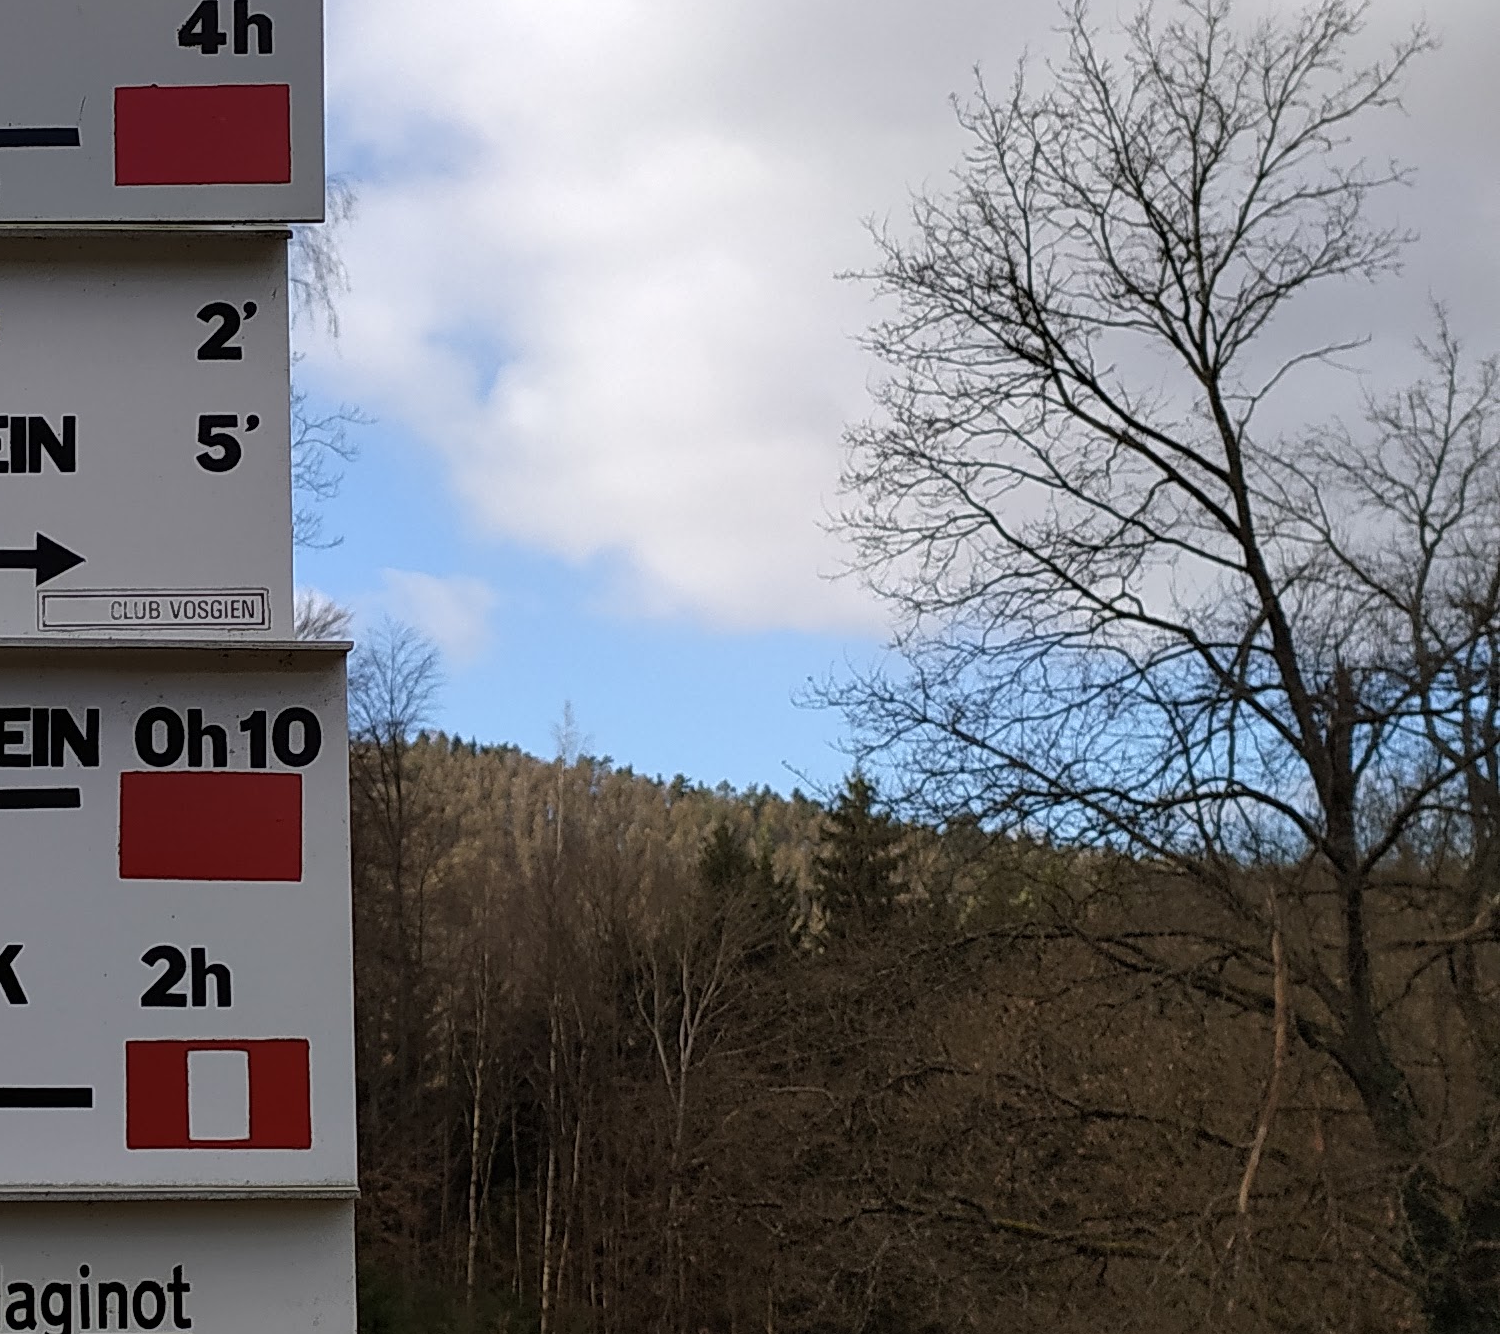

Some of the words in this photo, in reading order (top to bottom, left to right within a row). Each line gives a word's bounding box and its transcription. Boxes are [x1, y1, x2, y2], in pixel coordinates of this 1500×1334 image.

[178, 0, 274, 56] 4h
[111, 599, 162, 620] CLUB
[170, 598, 255, 620] VOSGIEN
[140, 945, 232, 1008] 2h
